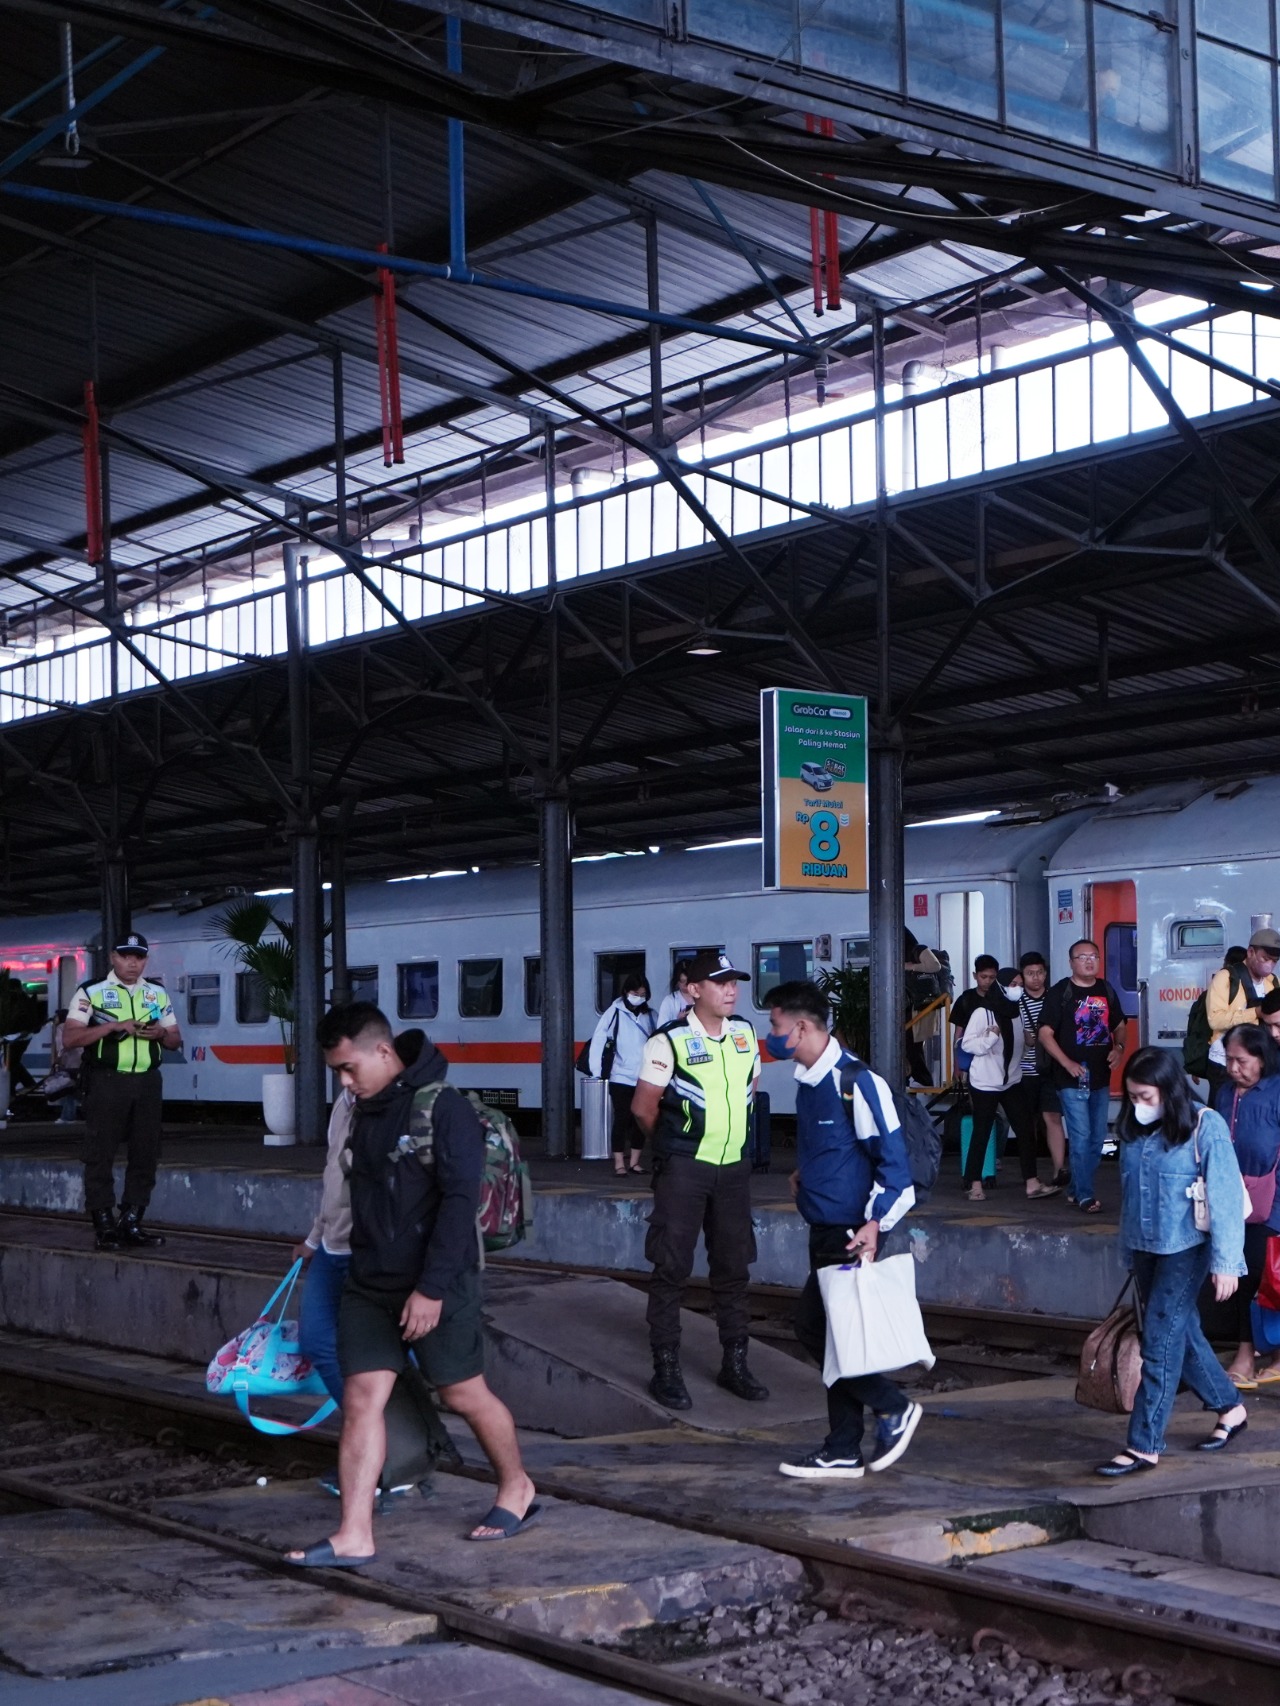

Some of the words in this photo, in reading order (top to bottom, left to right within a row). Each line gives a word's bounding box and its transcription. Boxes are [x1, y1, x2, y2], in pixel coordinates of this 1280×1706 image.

[793, 705, 828, 716] GrabCar
[784, 725, 804, 733] Jalan
[834, 729, 860, 738] Stasiun
[798, 738, 821, 748] Paling
[823, 740, 846, 749] Hemat
[804, 799, 822, 807] Tarif
[796, 811, 809, 824] Rp
[809, 810, 840, 862] 8
[802, 862, 848, 878] RIBUAN
